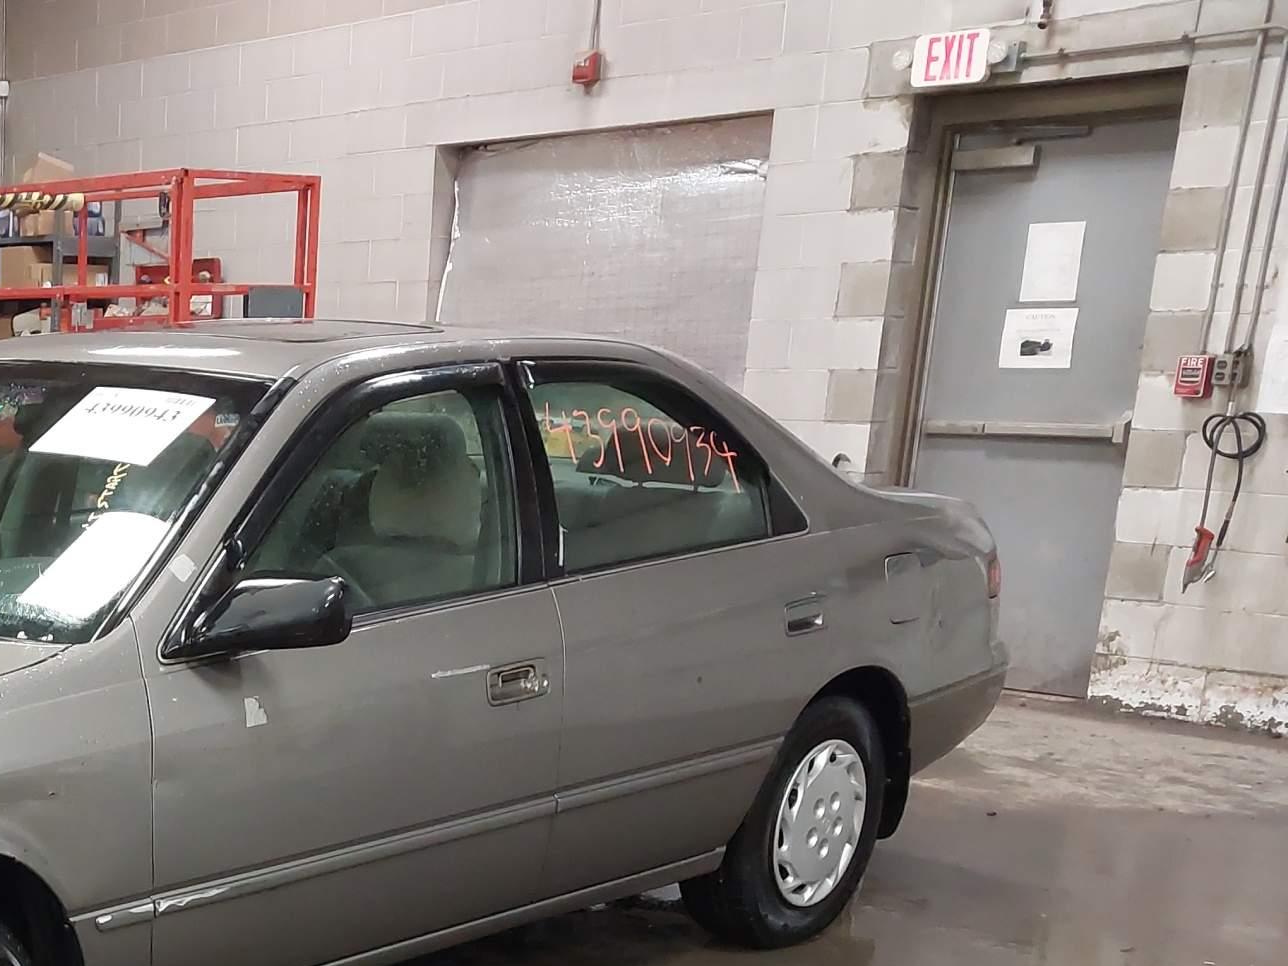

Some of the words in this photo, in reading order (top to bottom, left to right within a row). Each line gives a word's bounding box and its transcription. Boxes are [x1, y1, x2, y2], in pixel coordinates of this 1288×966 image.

[924, 32, 980, 81] EXIT
[1181, 356, 1205, 367] FIRE
[543, 401, 741, 494] 43990934
